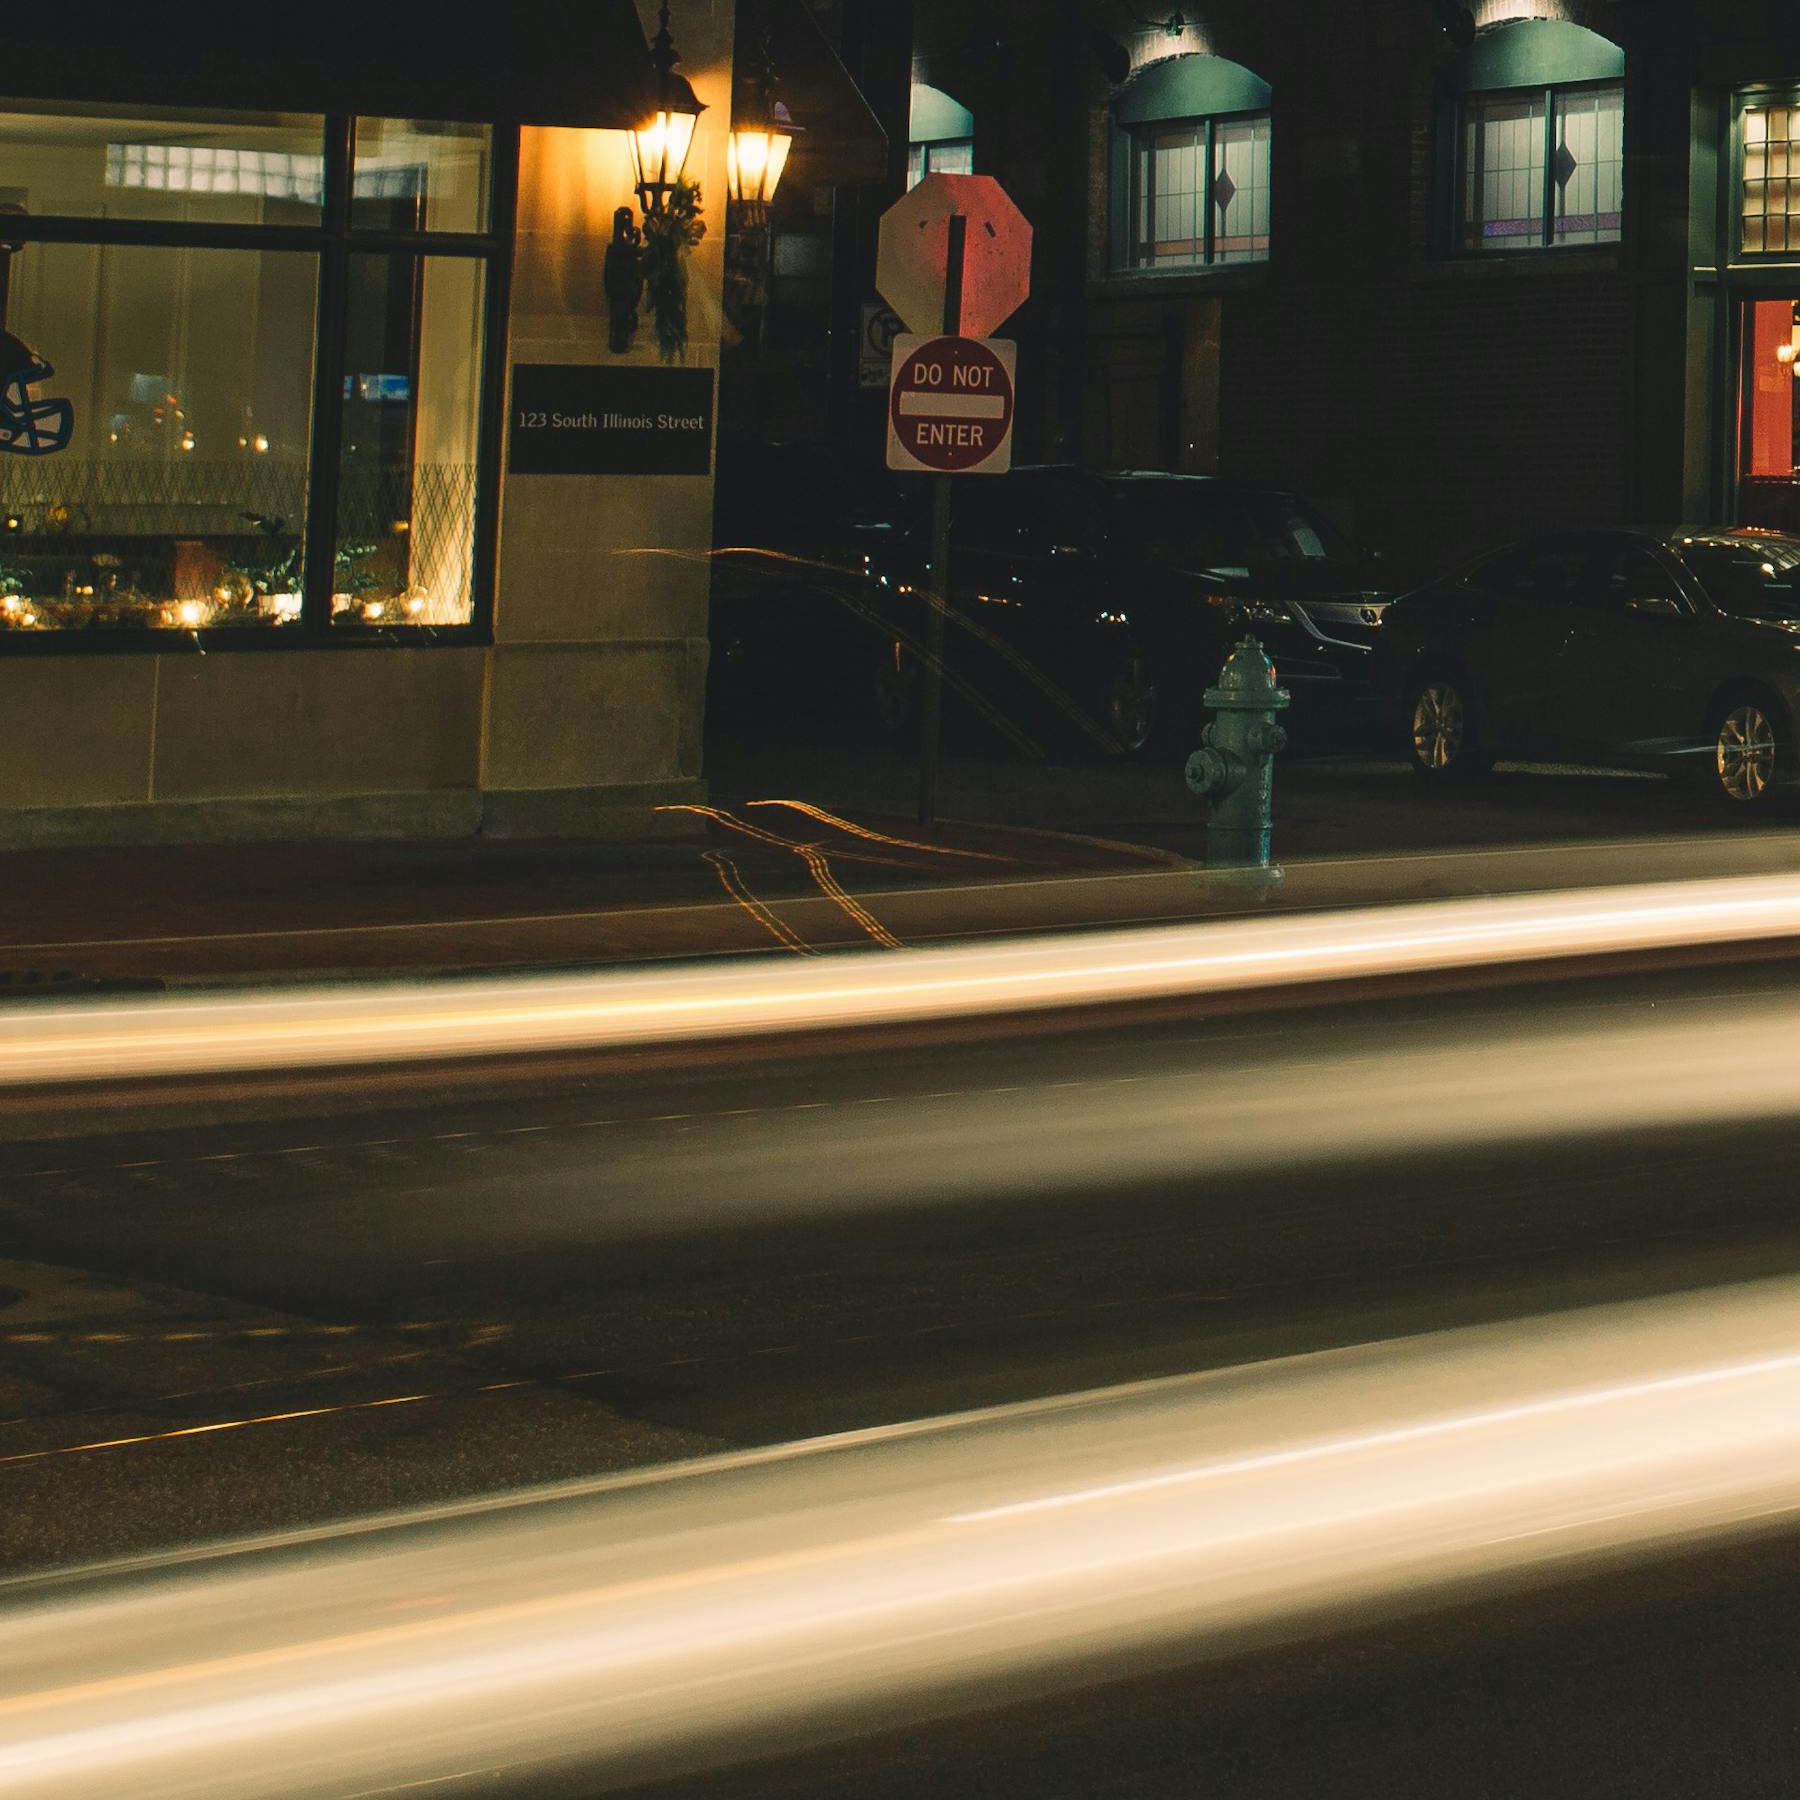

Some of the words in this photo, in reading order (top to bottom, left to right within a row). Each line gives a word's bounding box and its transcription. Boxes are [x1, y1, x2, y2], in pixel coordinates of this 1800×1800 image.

[912, 362, 943, 387] DO
[953, 365, 994, 389] NOT
[519, 411, 548, 429] 123
[551, 412, 598, 429] South
[603, 413, 654, 430] Illinois
[657, 414, 705, 431] Street
[916, 422, 984, 449] ENTER
